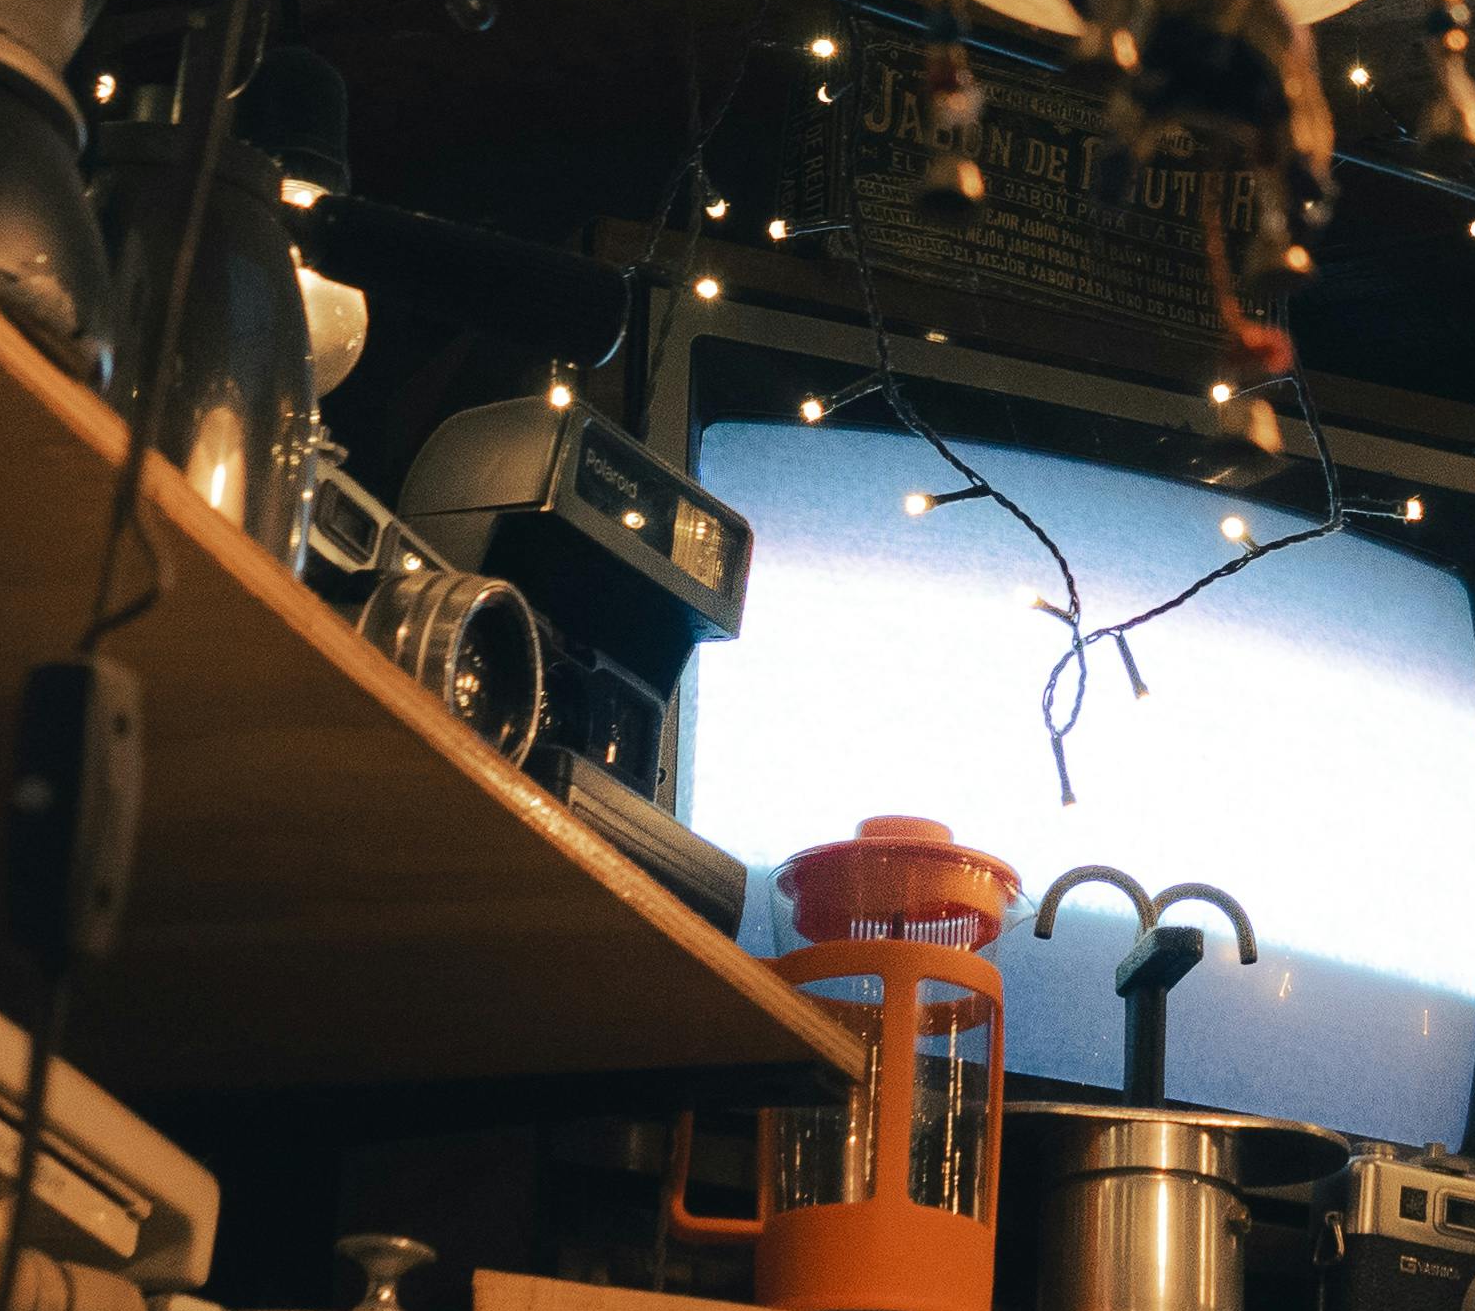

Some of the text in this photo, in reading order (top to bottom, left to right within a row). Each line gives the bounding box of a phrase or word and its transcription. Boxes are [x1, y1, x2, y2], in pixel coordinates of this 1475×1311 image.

[1026, 137, 1069, 184] DE
[890, 149, 1204, 251] EL JABON PARA LA TE
[985, 210, 1020, 234] EJOR
[953, 243, 973, 265] EL
[976, 248, 1026, 275] MEJOR
[1030, 260, 1074, 288] JABON
[1076, 273, 1114, 301] PARA
[1146, 294, 1166, 316] DE
[1168, 301, 1196, 324] LOS
[586, 447, 638, 499] Polaroid
